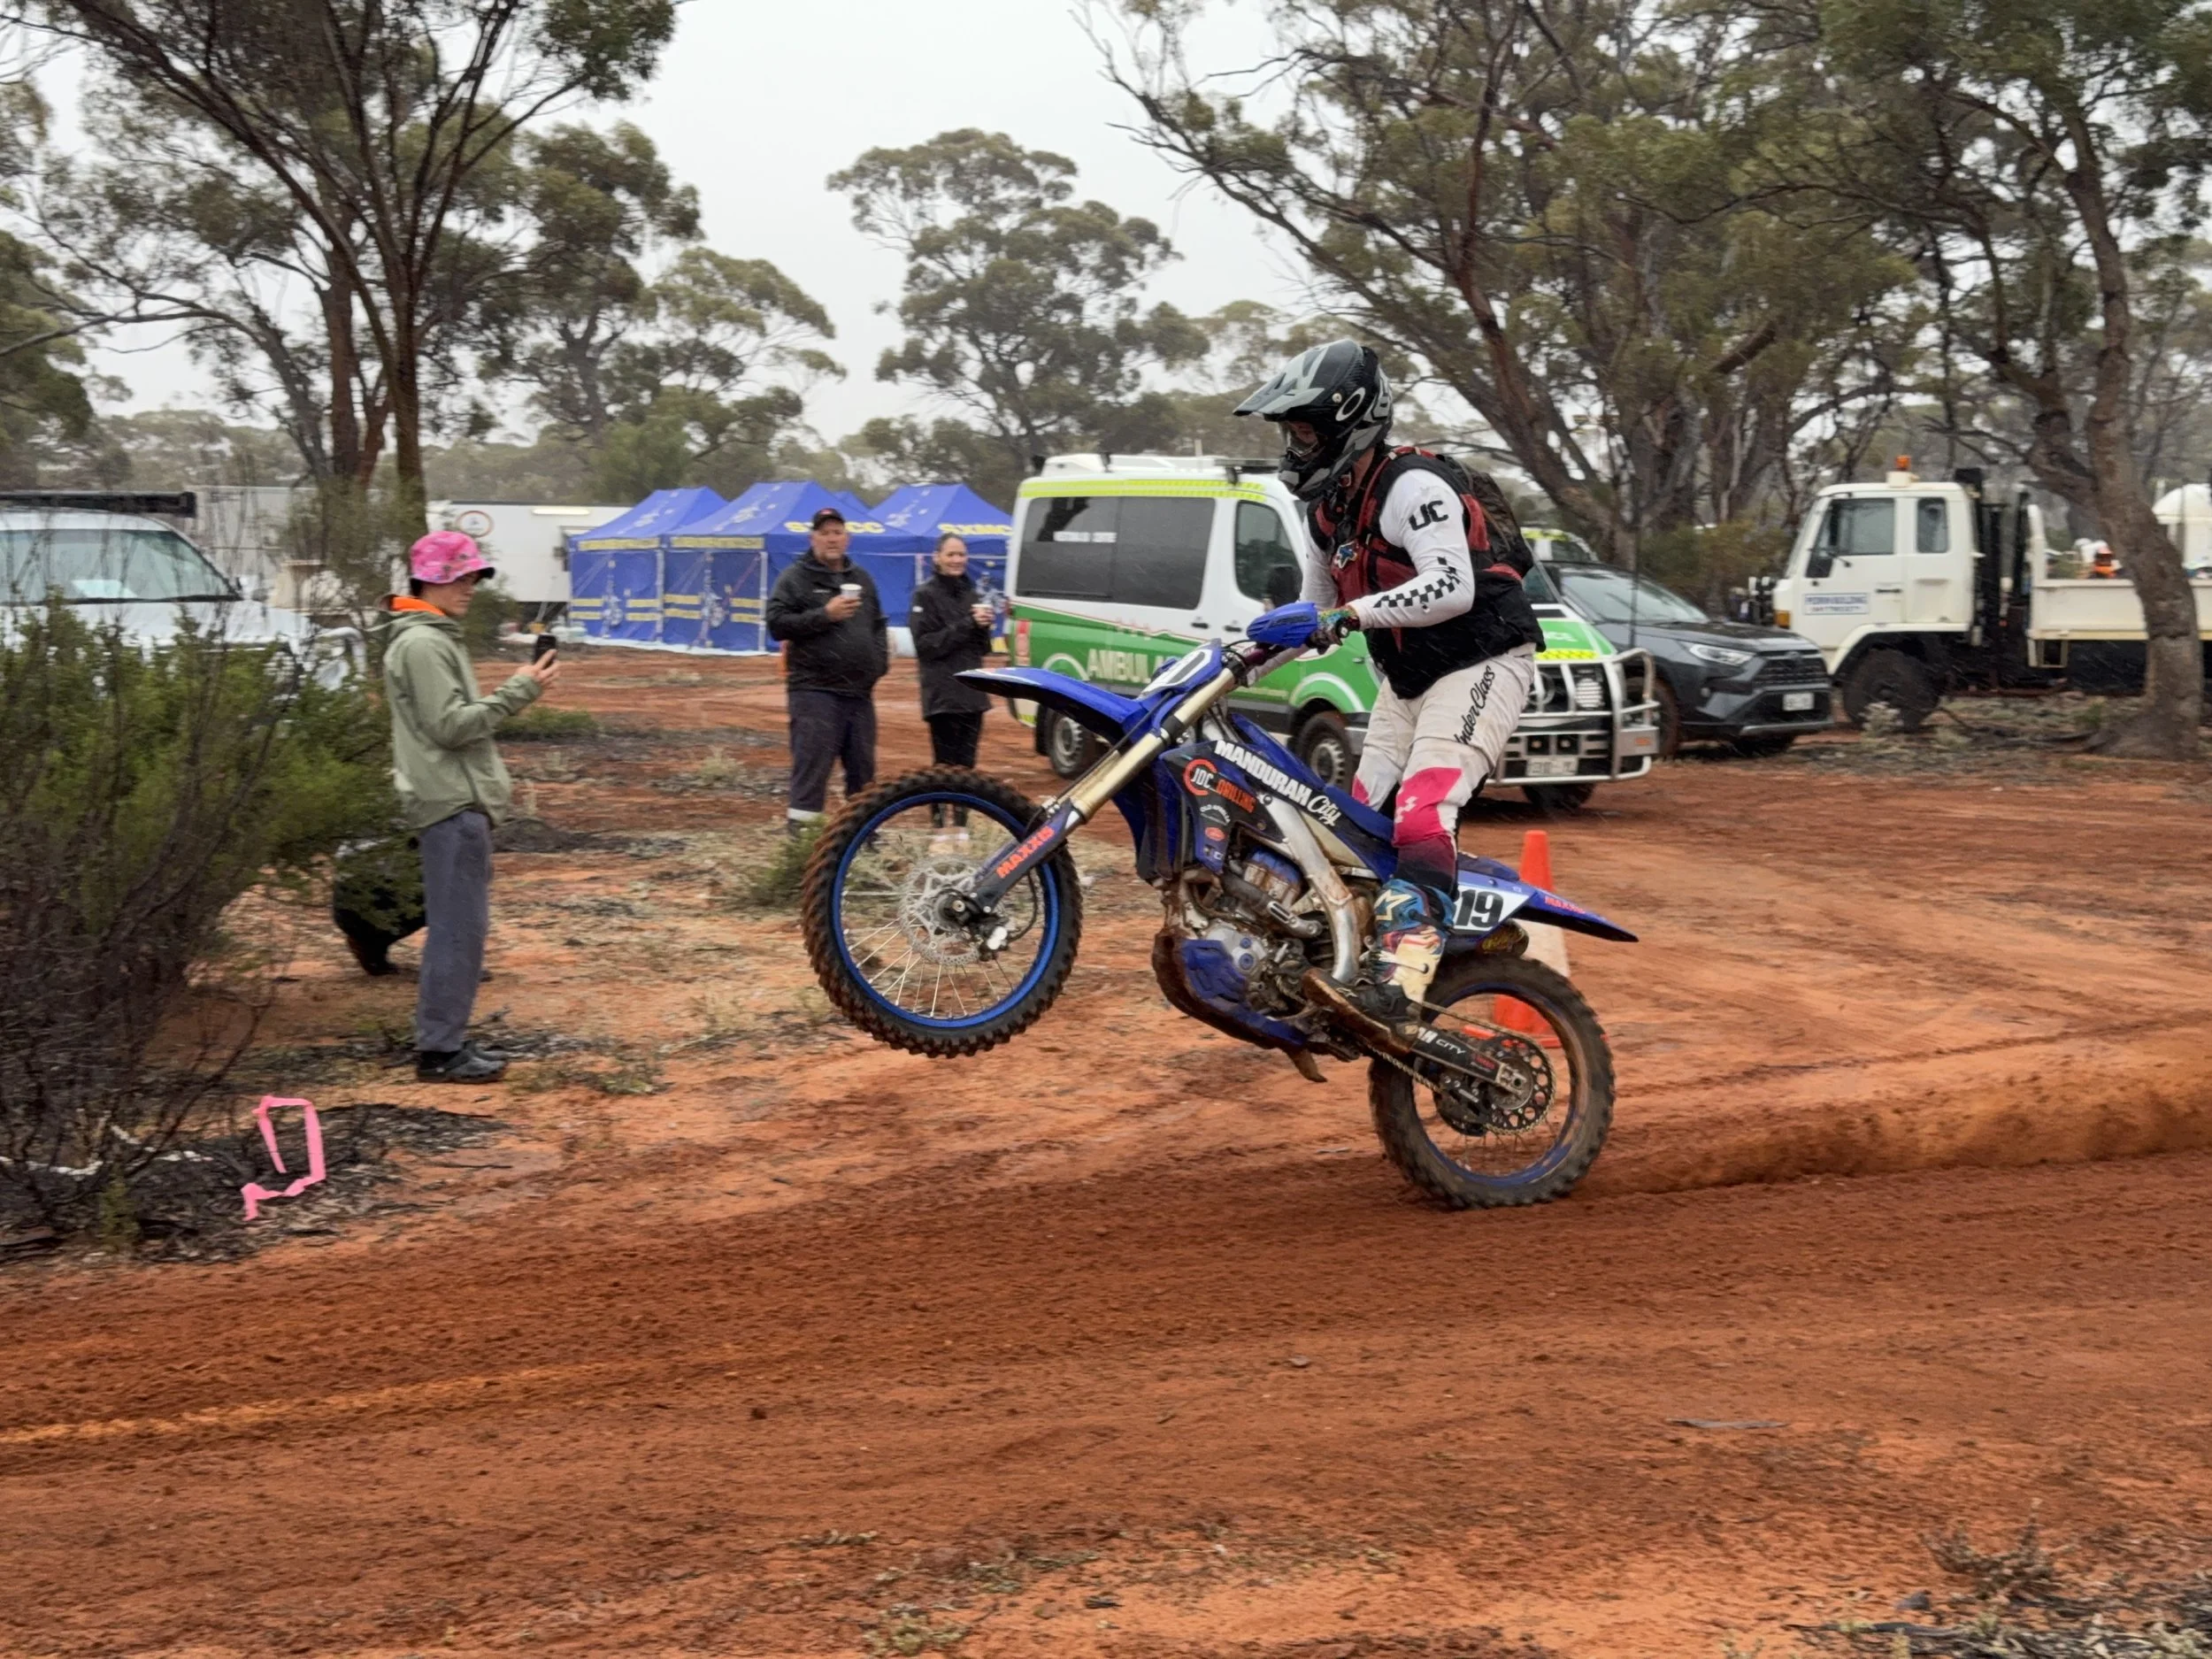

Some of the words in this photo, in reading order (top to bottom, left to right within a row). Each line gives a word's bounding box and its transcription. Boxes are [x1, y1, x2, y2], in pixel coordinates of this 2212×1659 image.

[1409, 500, 1449, 531] UC
[1190, 767, 1214, 788] JDC
[1214, 740, 1312, 807] MANDURAH
[1307, 795, 1341, 826] City
[996, 825, 1055, 879] MAXXIS
[1455, 889, 1504, 928] 19
[1436, 1039, 1466, 1055] CITY
